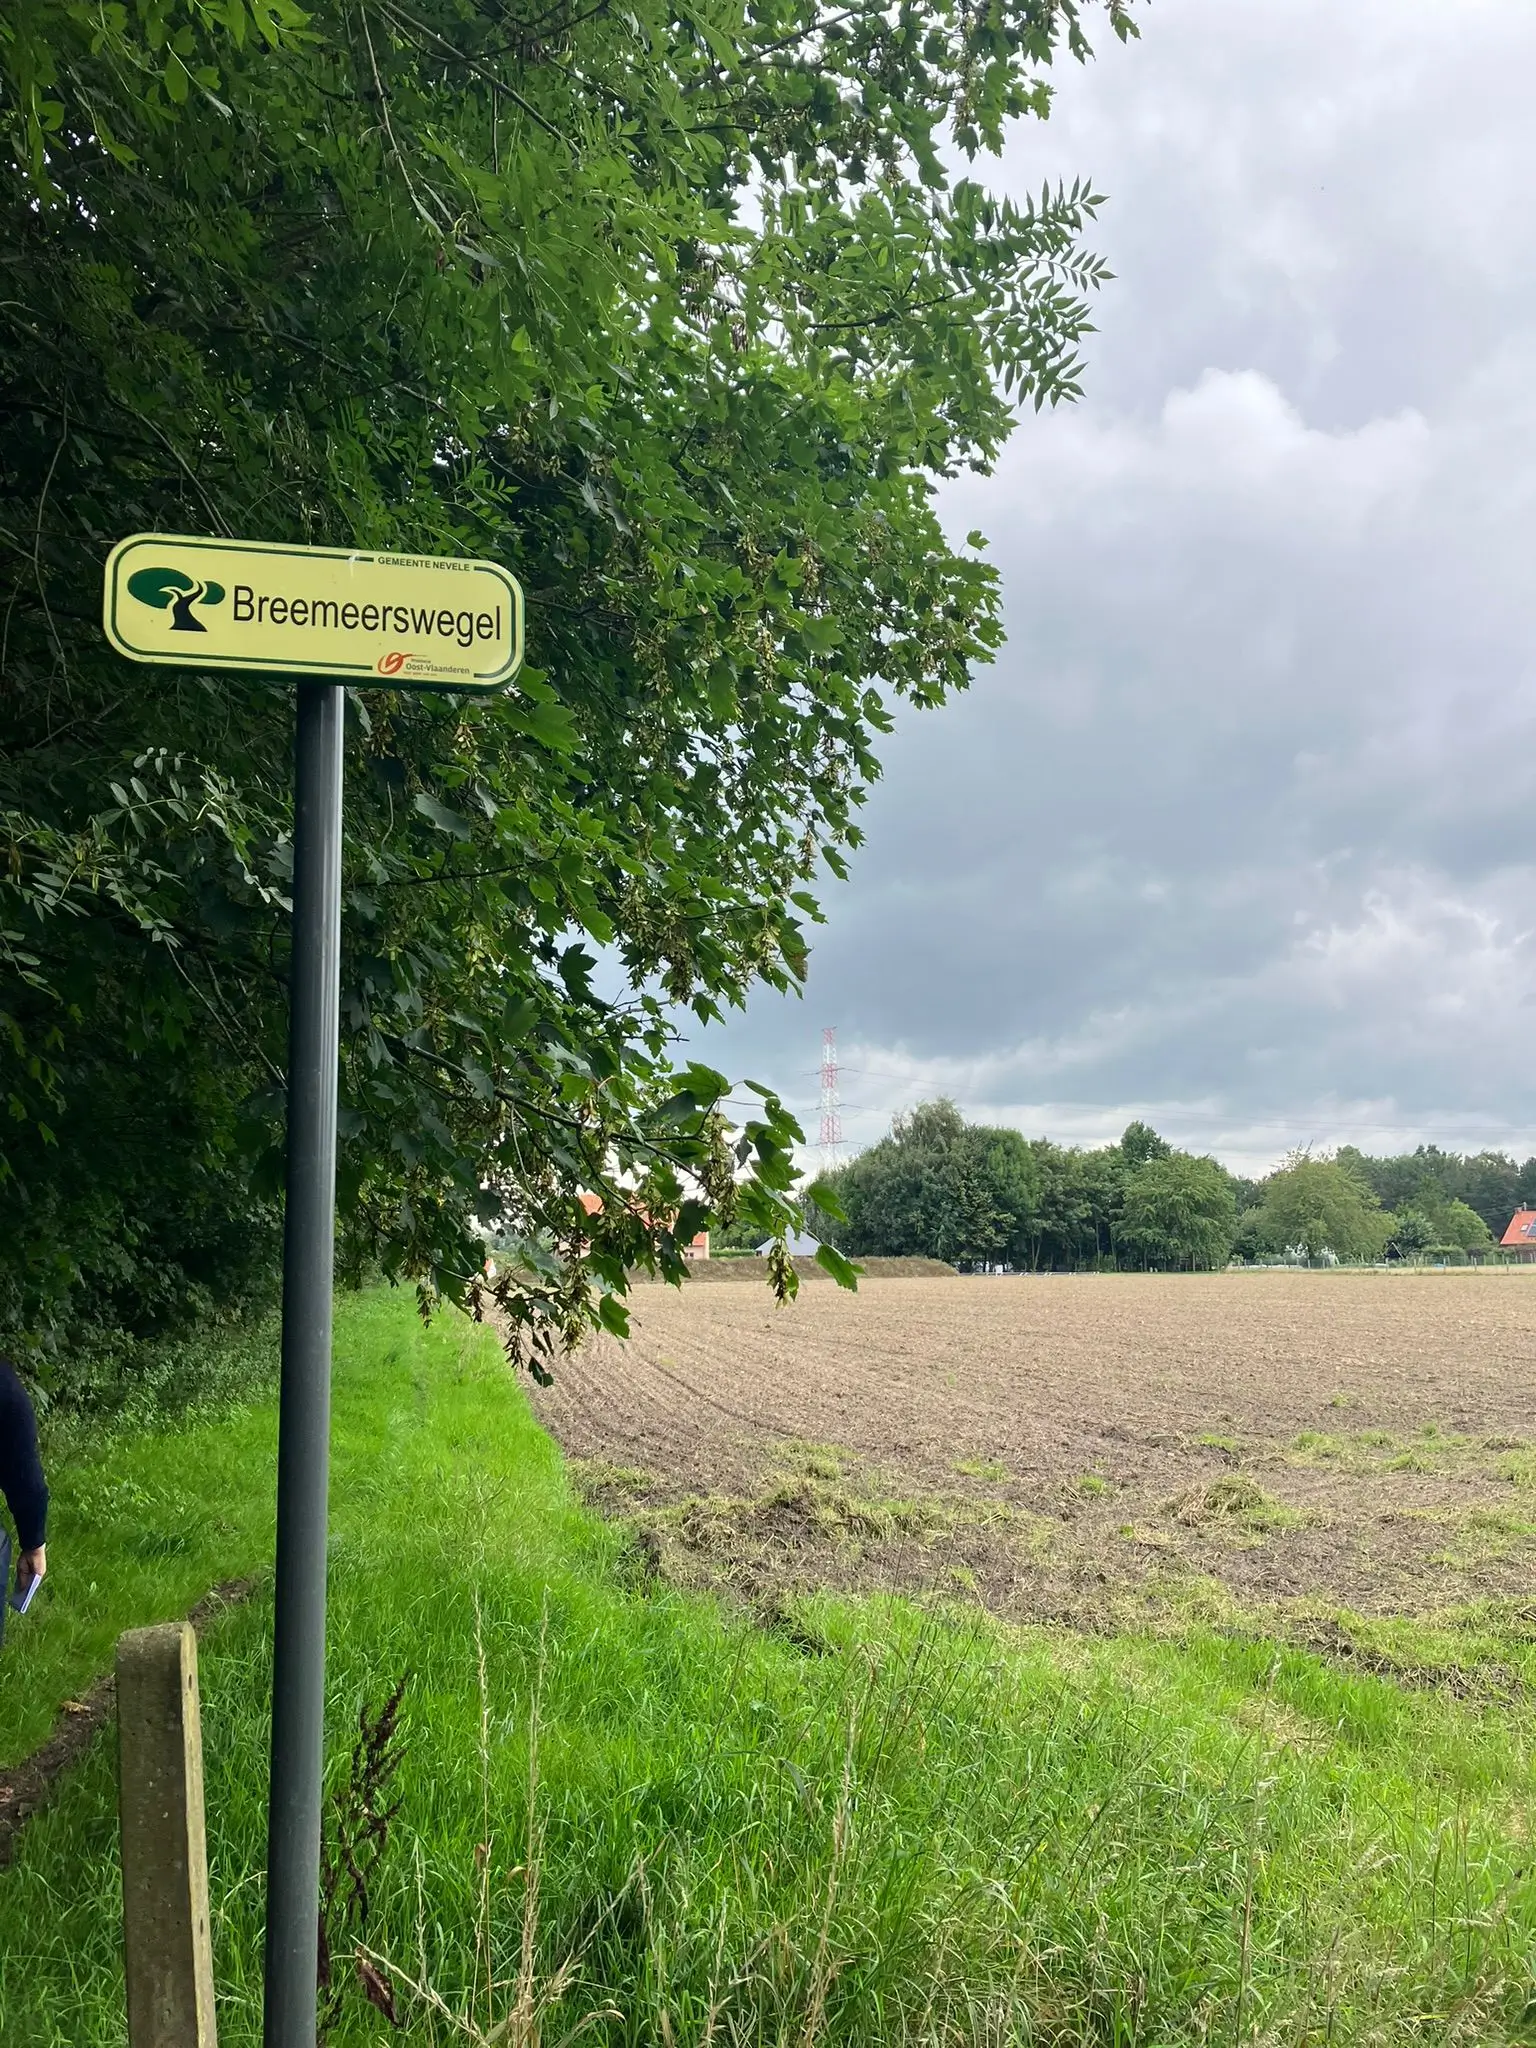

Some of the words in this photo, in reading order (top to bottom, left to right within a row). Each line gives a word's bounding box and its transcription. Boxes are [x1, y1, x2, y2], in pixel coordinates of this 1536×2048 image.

[377, 556, 431, 569] GEMEENTE
[432, 561, 470, 572] NEVELE
[233, 585, 501, 648] Breemeerswegel
[405, 662, 470, 674] Oost-Vlaanderen
